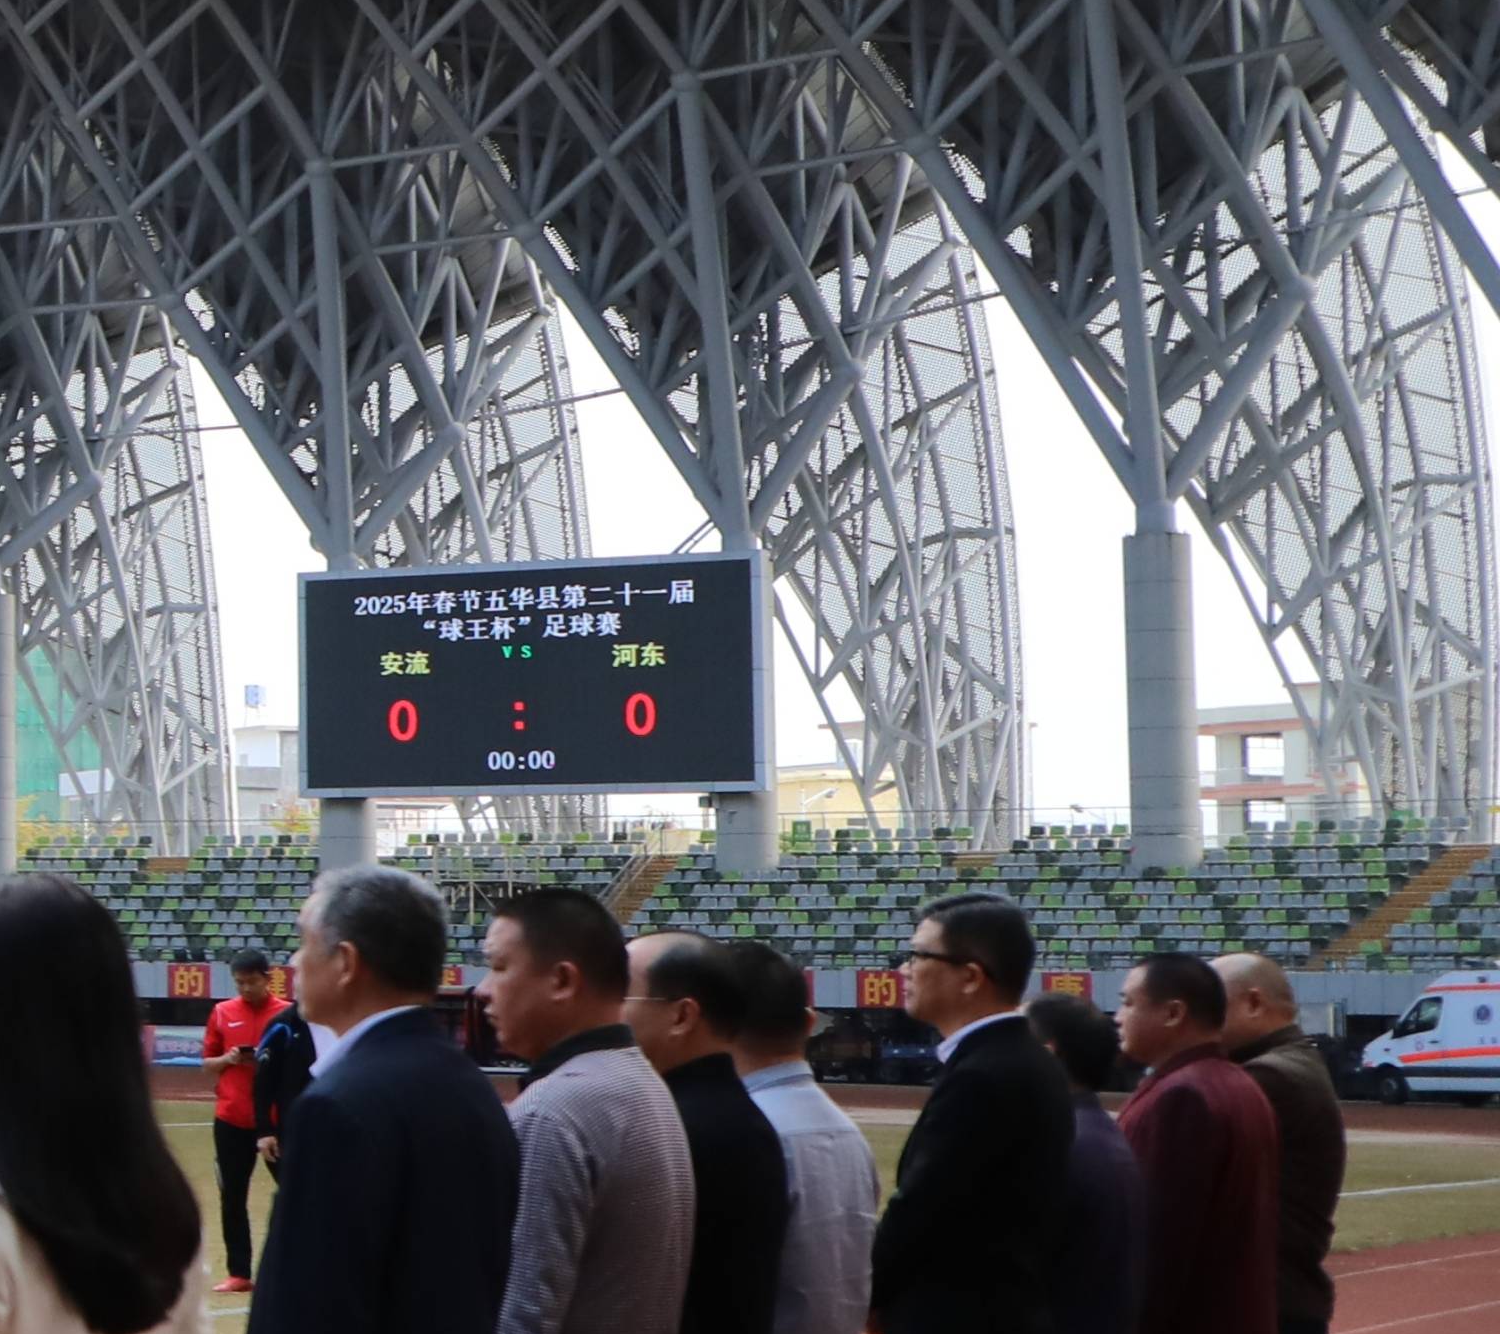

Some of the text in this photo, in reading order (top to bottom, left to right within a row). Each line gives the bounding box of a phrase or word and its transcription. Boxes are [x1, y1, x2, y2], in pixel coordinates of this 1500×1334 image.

[353, 578, 696, 616] 2025年春节五华县第二十一届
[379, 650, 432, 677] 安流
[611, 641, 667, 668] 河东
[387, 699, 419, 742] 0
[624, 692, 656, 736] 0
[486, 749, 556, 771] 00:00
[174, 967, 204, 996] 的
[863, 974, 897, 1007] 的
